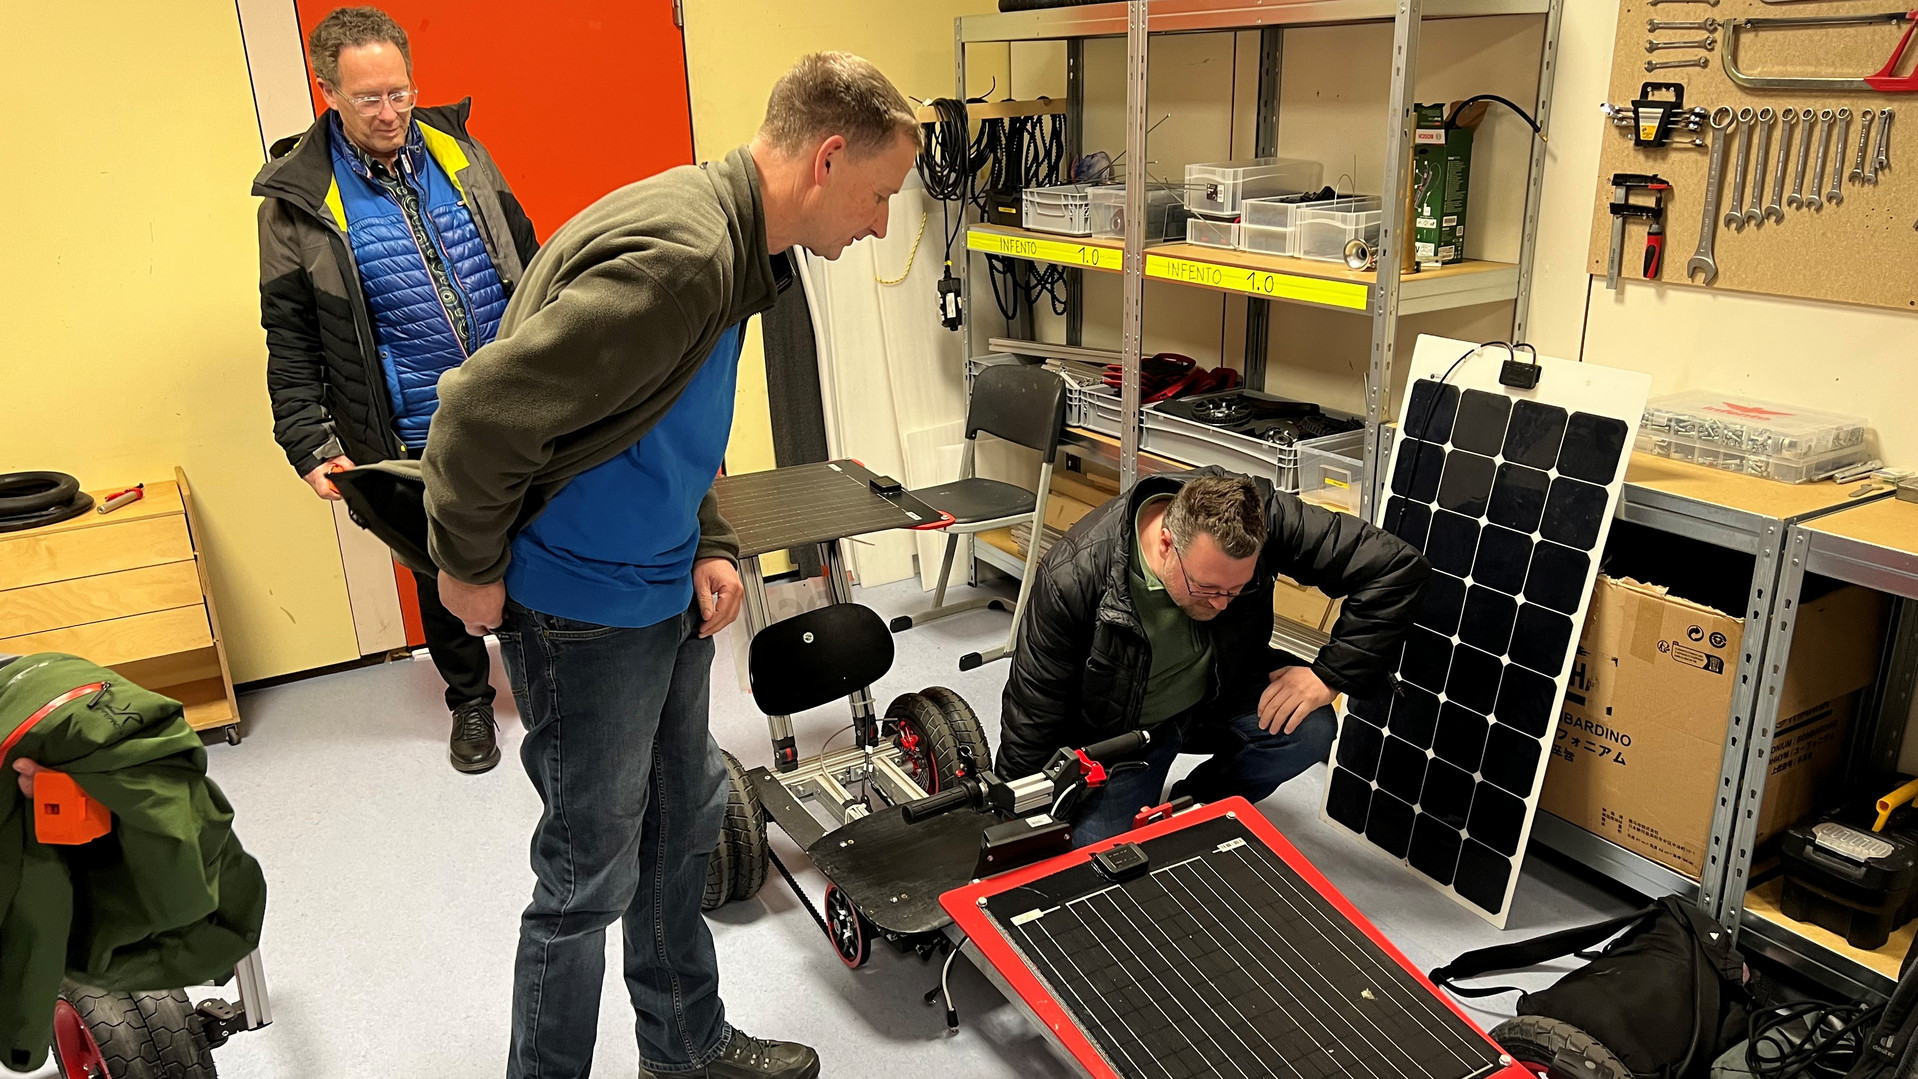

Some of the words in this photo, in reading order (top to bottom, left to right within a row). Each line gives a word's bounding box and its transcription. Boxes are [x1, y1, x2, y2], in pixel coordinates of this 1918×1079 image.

[1000, 237, 1037, 255] INFENTO
[1078, 246, 1100, 265] 1.0
[1167, 261, 1222, 284] INFENTO
[1247, 271, 1275, 293] 1.0
[1559, 712, 1632, 747] BARDINO
